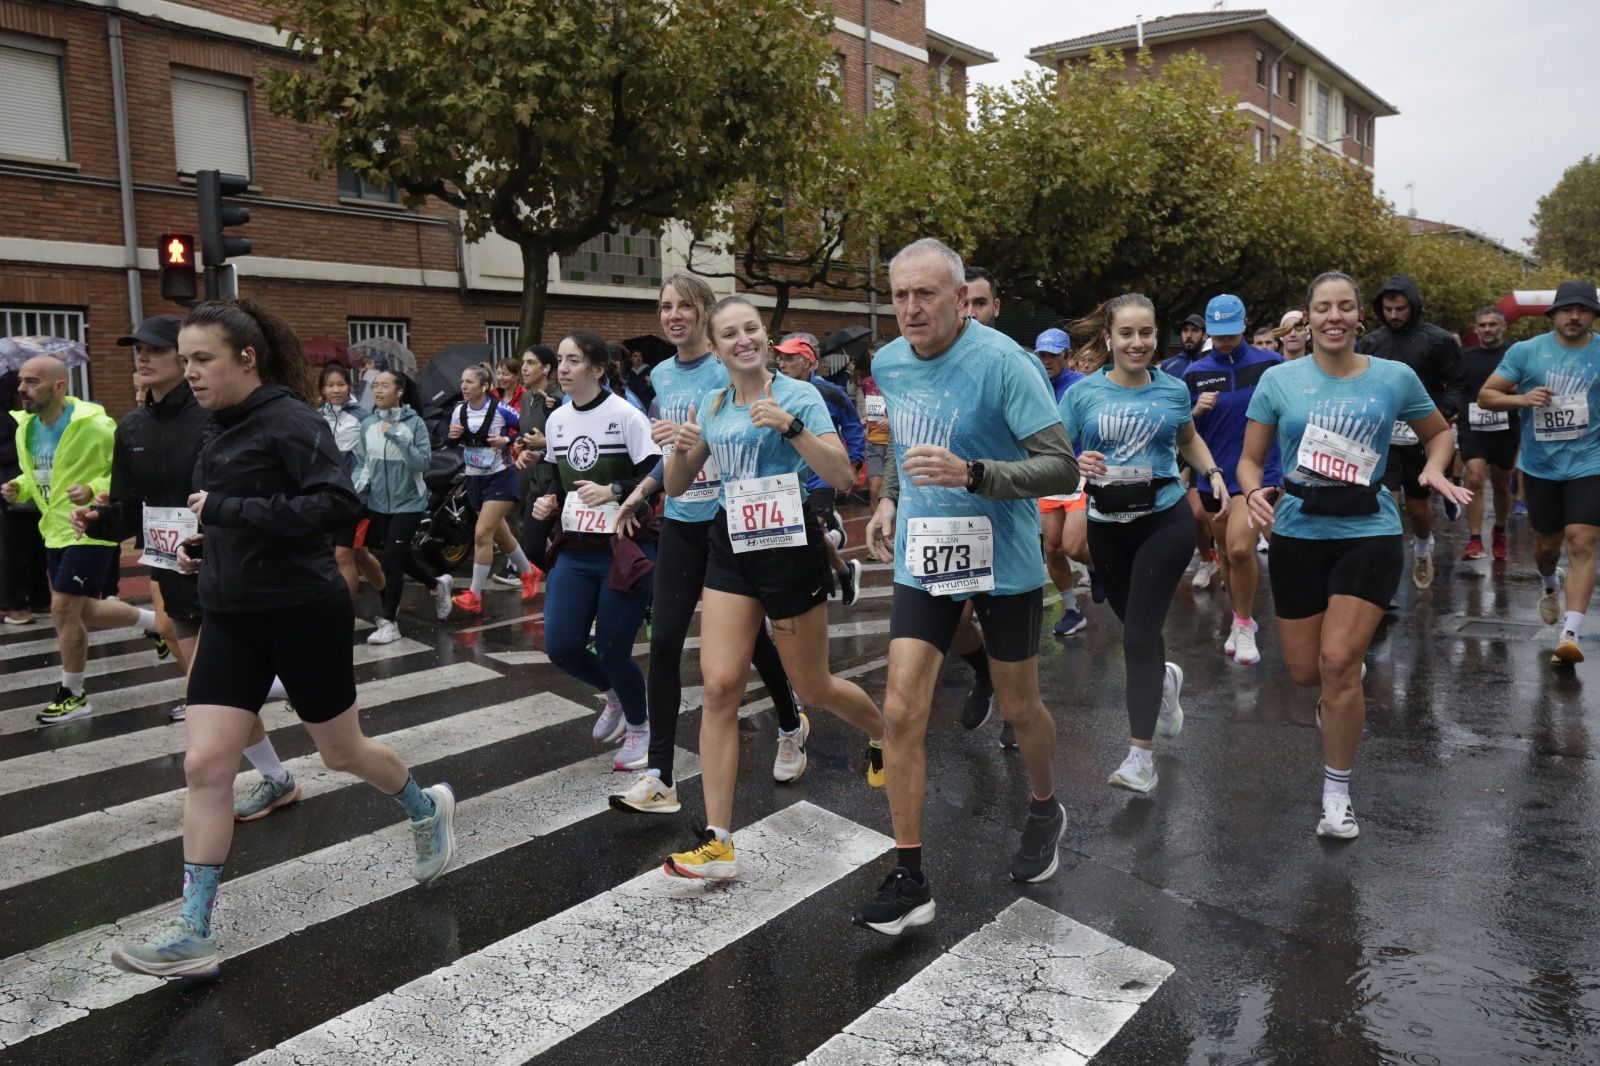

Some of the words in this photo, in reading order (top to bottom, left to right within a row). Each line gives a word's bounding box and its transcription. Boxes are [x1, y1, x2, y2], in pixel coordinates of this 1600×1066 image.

[1478, 412, 1499, 424] 750
[1544, 410, 1575, 428] 862
[1312, 450, 1359, 484] 1090
[575, 510, 607, 532] 724
[742, 500, 785, 531] 874
[149, 528, 179, 553] 852
[759, 535, 793, 545] HYUNDAI
[923, 545, 971, 575] 873
[937, 578, 980, 589] HYUNDAI
